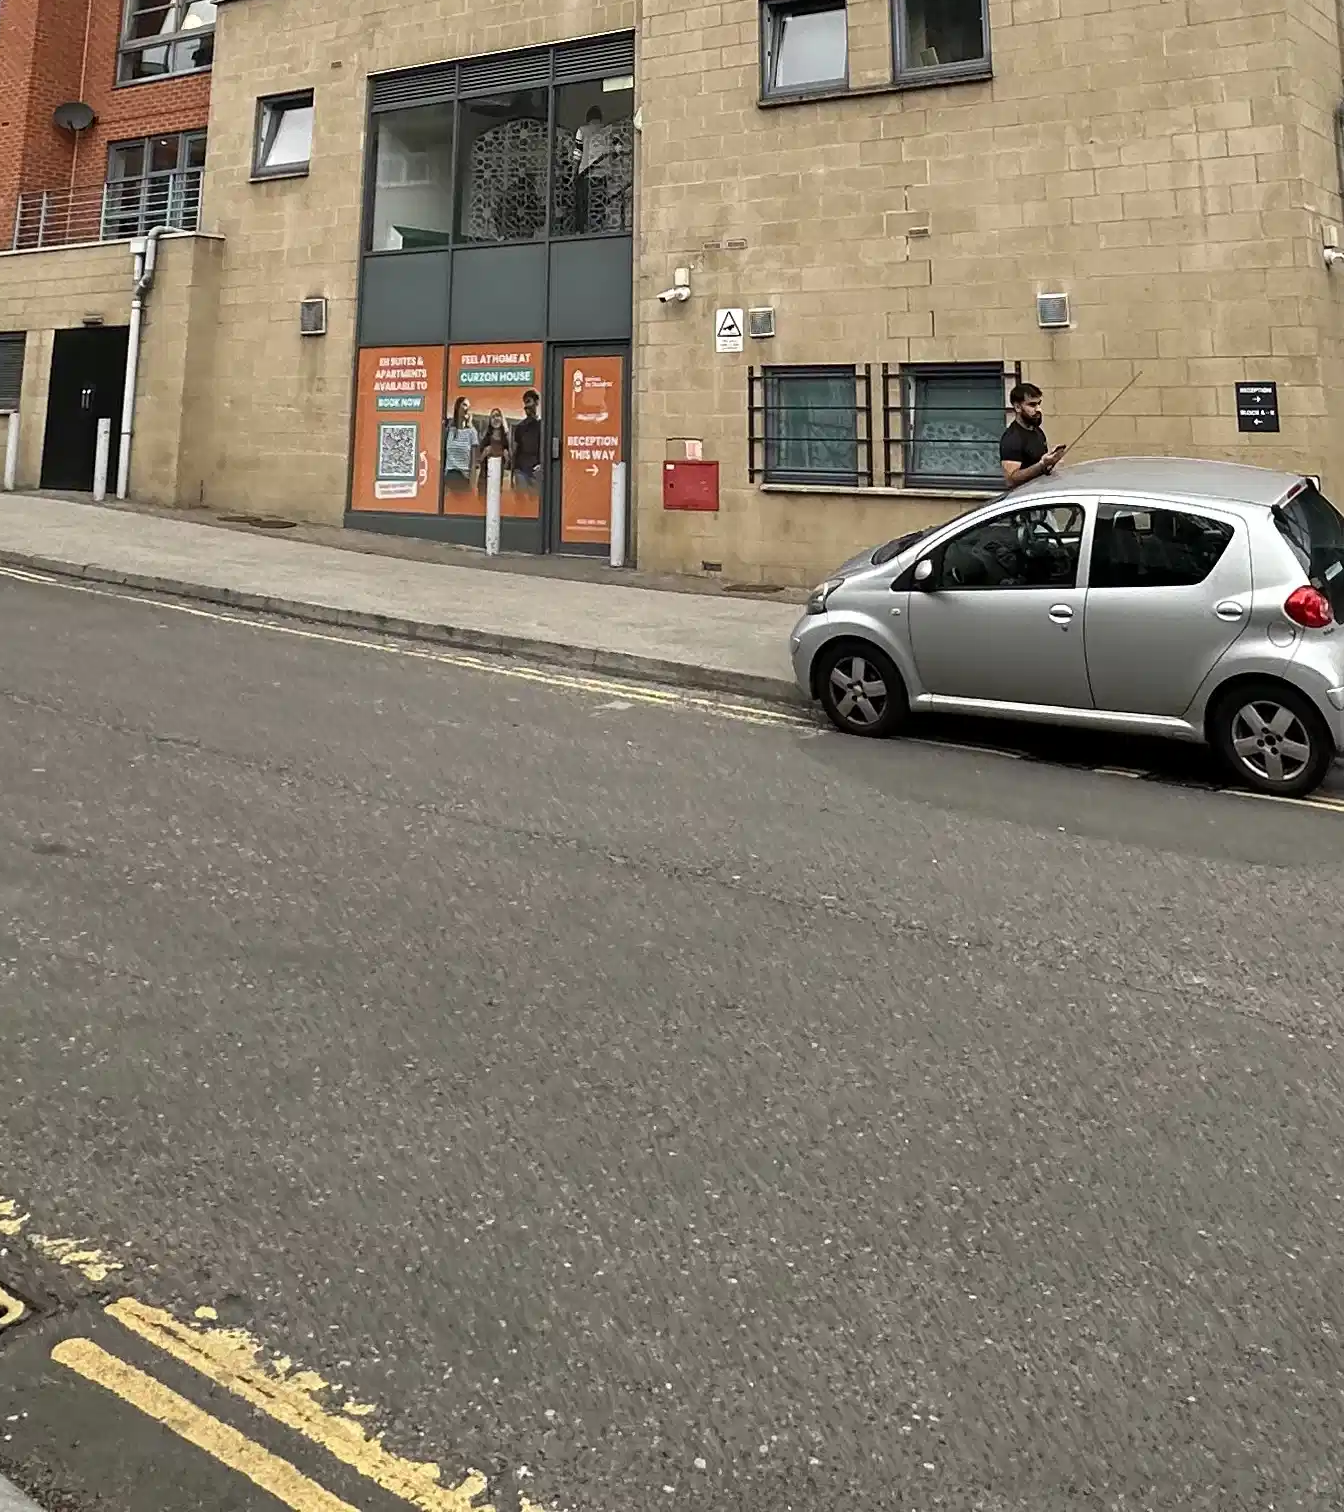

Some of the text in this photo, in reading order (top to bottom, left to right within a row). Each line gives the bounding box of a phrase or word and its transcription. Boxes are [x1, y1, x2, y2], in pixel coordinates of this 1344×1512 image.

[461, 353, 531, 365] FEEL AT HOME AT
[375, 368, 427, 379] APARTMENTS
[460, 371, 531, 382] CURZON HOUSE
[374, 380, 428, 391] AVAILABLE TO
[378, 397, 422, 408] BOOK NOW
[567, 436, 618, 446] RECEPTION
[570, 450, 615, 460] THIS WAY
